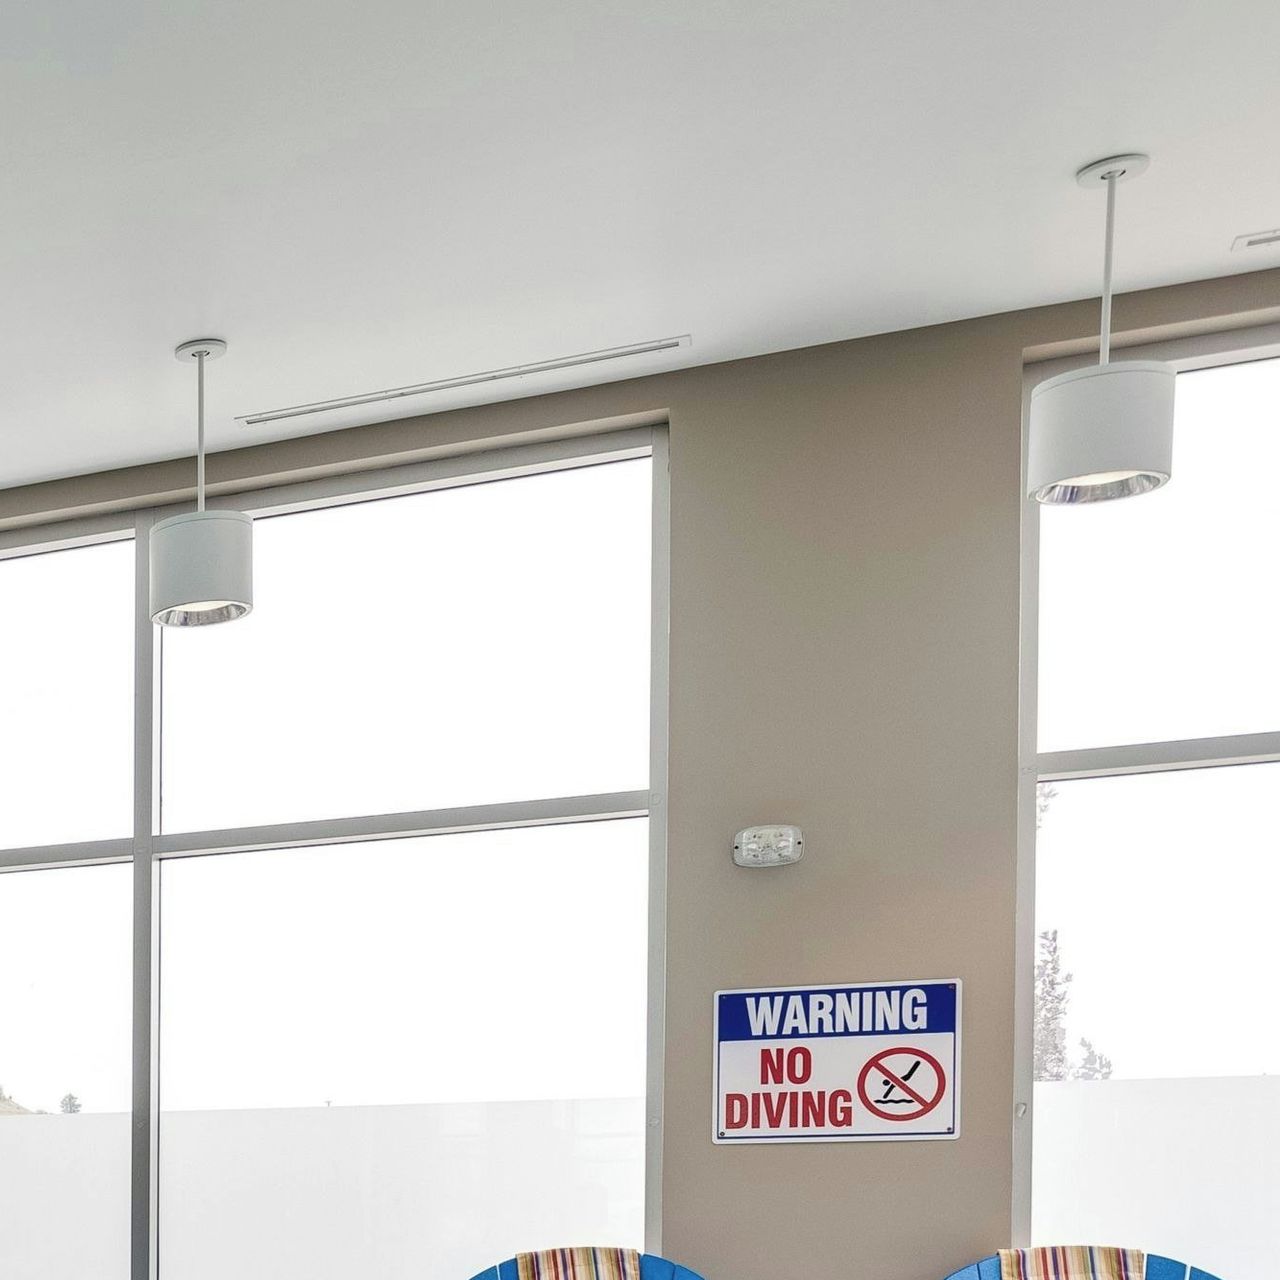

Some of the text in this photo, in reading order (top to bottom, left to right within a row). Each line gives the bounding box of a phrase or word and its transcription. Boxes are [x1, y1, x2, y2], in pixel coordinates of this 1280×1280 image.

[746, 989, 927, 1036] WARNING
[760, 1046, 812, 1085] NO
[725, 1089, 853, 1130] DIVING
